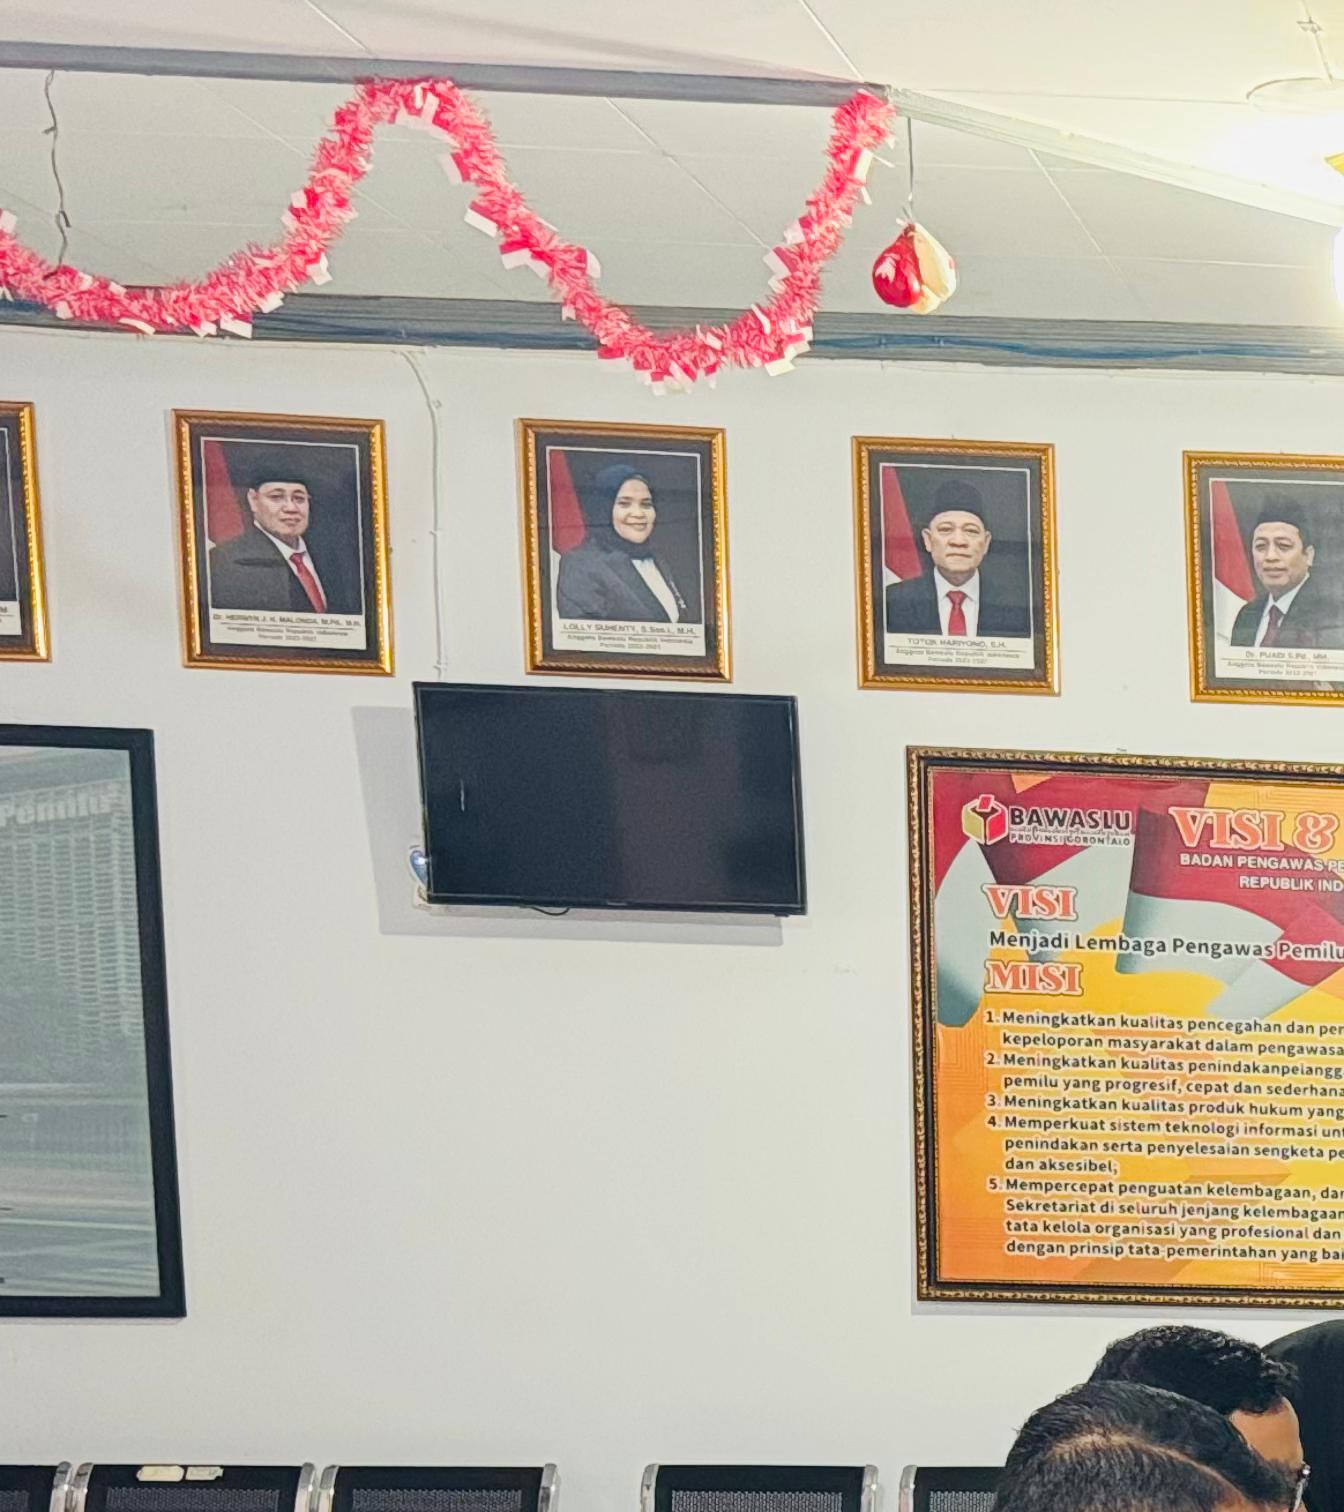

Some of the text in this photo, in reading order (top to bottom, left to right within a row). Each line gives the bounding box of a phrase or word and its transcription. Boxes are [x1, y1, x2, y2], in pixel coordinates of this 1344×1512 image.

[1010, 806, 1131, 831] BAWASLU
[1172, 807, 1283, 851] VISI
[1289, 811, 1338, 853] &
[1180, 853, 1233, 868] BADAN
[1237, 855, 1324, 871] PENGAWAS
[1239, 875, 1313, 891] REPUBLIK
[983, 884, 1077, 921] VISI
[990, 930, 1069, 952] Menjadi
[1075, 934, 1166, 958] Lembaga
[1173, 937, 1273, 960] Pengawas
[986, 960, 1085, 996] MISI
[1003, 1011, 1115, 1030] Meningkatkan
[1120, 1015, 1183, 1030] kualitas
[1188, 1017, 1281, 1036] pencegahan
[1286, 1020, 1314, 1034] dan
[1003, 1032, 1103, 1051] kepeloporan
[1108, 1036, 1200, 1054] masyarakat
[1205, 1038, 1252, 1052] dalam
[1003, 1053, 1116, 1072] Meningkatkan
[1121, 1057, 1183, 1071] kualitas
[1003, 1074, 1058, 1092] pemilu
[1062, 1080, 1100, 1093] yang
[1186, 1080, 1228, 1097] cepat
[1233, 1081, 1261, 1095] dan
[1004, 1095, 1116, 1114] Meningkatkan
[1121, 1098, 1184, 1113] kualitas
[1188, 1100, 1244, 1117] produk
[1249, 1102, 1302, 1116] hukum
[1307, 1107, 1344, 1120] yang
[1005, 1116, 1105, 1134] Memperkuat
[1110, 1119, 1160, 1133] sistem
[1165, 1120, 1239, 1138] teknologi
[1244, 1122, 1316, 1137] informasi
[1005, 1137, 1097, 1155] penindakan
[1103, 1140, 1142, 1153] serta
[1147, 1141, 1249, 1159] penyelesaian
[1254, 1144, 1323, 1161] sengketa
[1005, 1158, 1034, 1171] dan
[1006, 1178, 1113, 1196] Mempercepat
[1118, 1181, 1201, 1199] penguatan
[1006, 1199, 1095, 1214] Sekretariat
[1100, 1201, 1114, 1214] di
[1118, 1202, 1177, 1216] seluruh
[1181, 1203, 1239, 1220] jenjang
[1006, 1220, 1037, 1233] tata
[1042, 1221, 1090, 1234] kelola
[1095, 1222, 1174, 1239] organisasi
[1179, 1227, 1217, 1240] yang
[1221, 1225, 1308, 1242] profesional
[1313, 1227, 1340, 1240] dan
[1007, 1240, 1064, 1257] dengan
[1069, 1242, 1125, 1258] prinsip
[1128, 1243, 1159, 1256] tata
[1167, 1244, 1276, 1262] pemerintahan
[1280, 1250, 1317, 1263] yang
